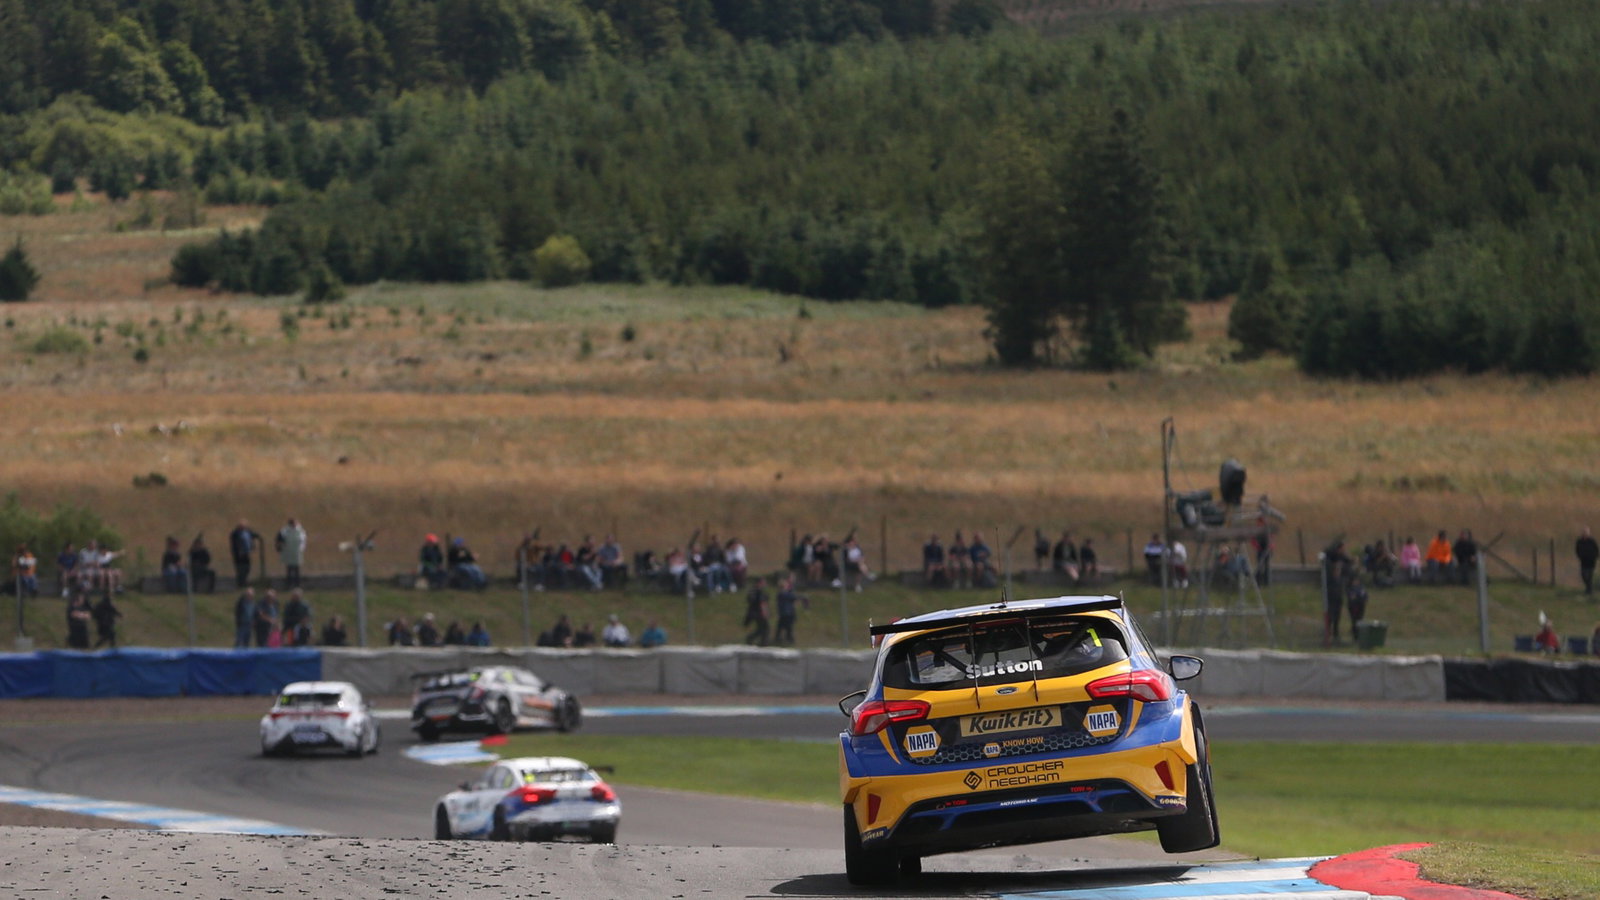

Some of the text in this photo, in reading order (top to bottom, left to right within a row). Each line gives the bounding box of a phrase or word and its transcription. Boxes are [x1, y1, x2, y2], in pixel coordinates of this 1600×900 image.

[1087, 628, 1103, 647] 1
[965, 659, 1043, 679] Sutton
[1088, 712, 1116, 730] NAPA
[908, 733, 936, 751] NAPA
[985, 736, 1044, 754] NAPA KNOW HOW
[987, 760, 1065, 777] CROUCHER
[989, 772, 1060, 788] NEEDHAM
